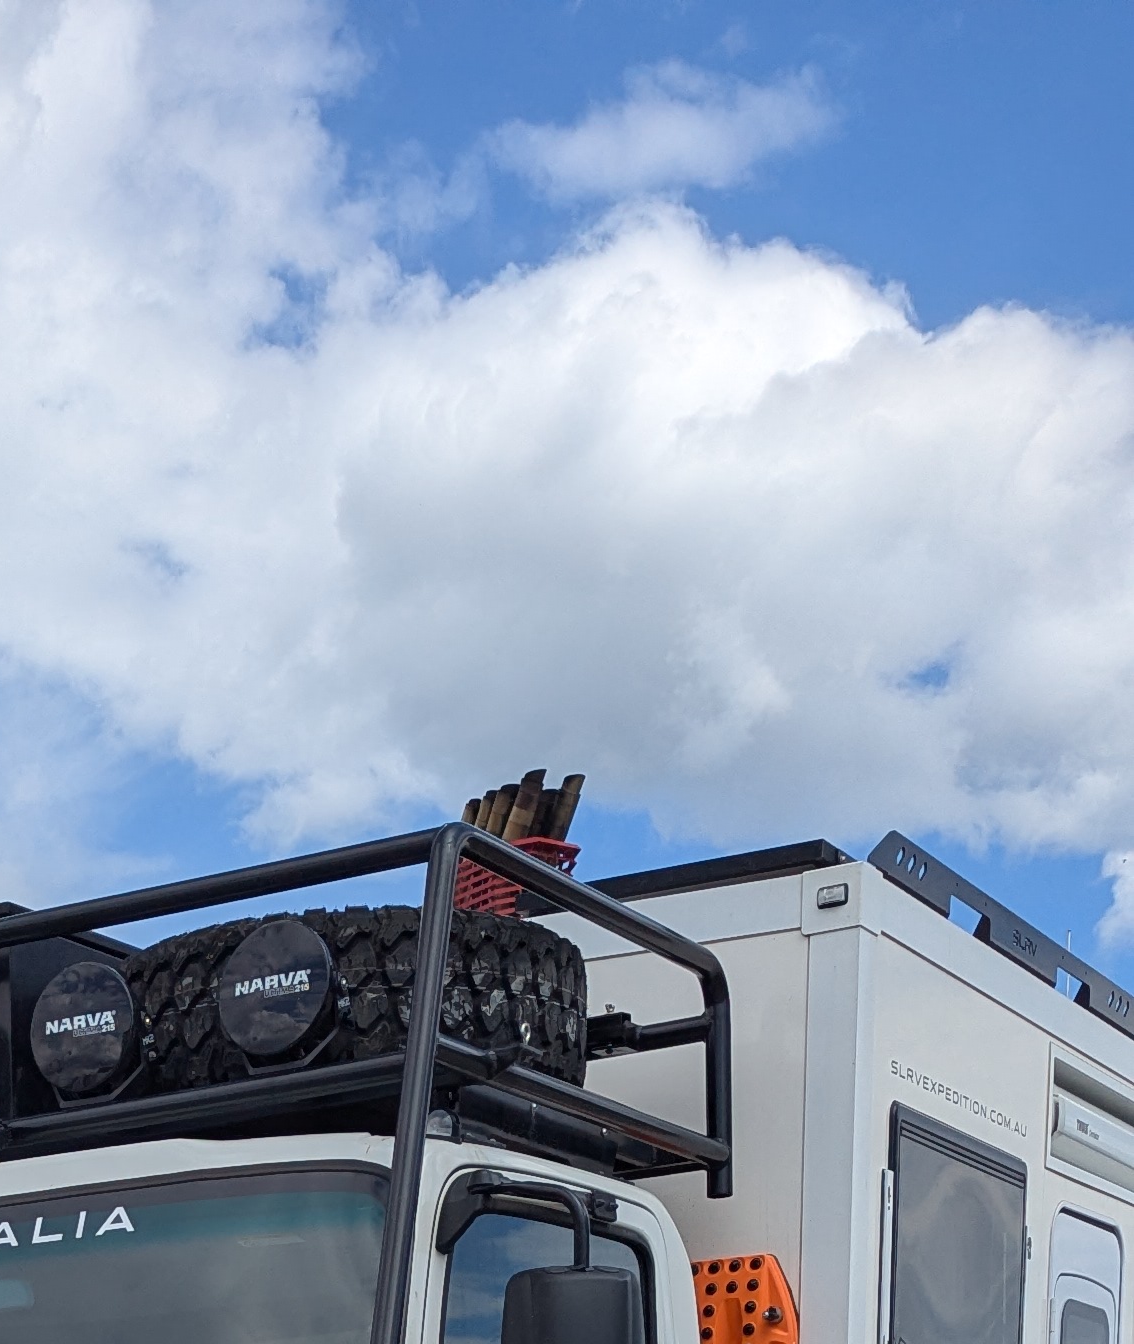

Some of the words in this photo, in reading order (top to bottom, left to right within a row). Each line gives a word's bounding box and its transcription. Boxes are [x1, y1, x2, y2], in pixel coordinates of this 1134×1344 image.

[1012, 929, 1038, 957] SLRV
[234, 969, 310, 997] NARVA
[46, 1010, 116, 1035] NARVA
[101, 1023, 116, 1033] 215
[890, 1060, 1028, 1138] SLRVEXPEDITION.COM.AU
